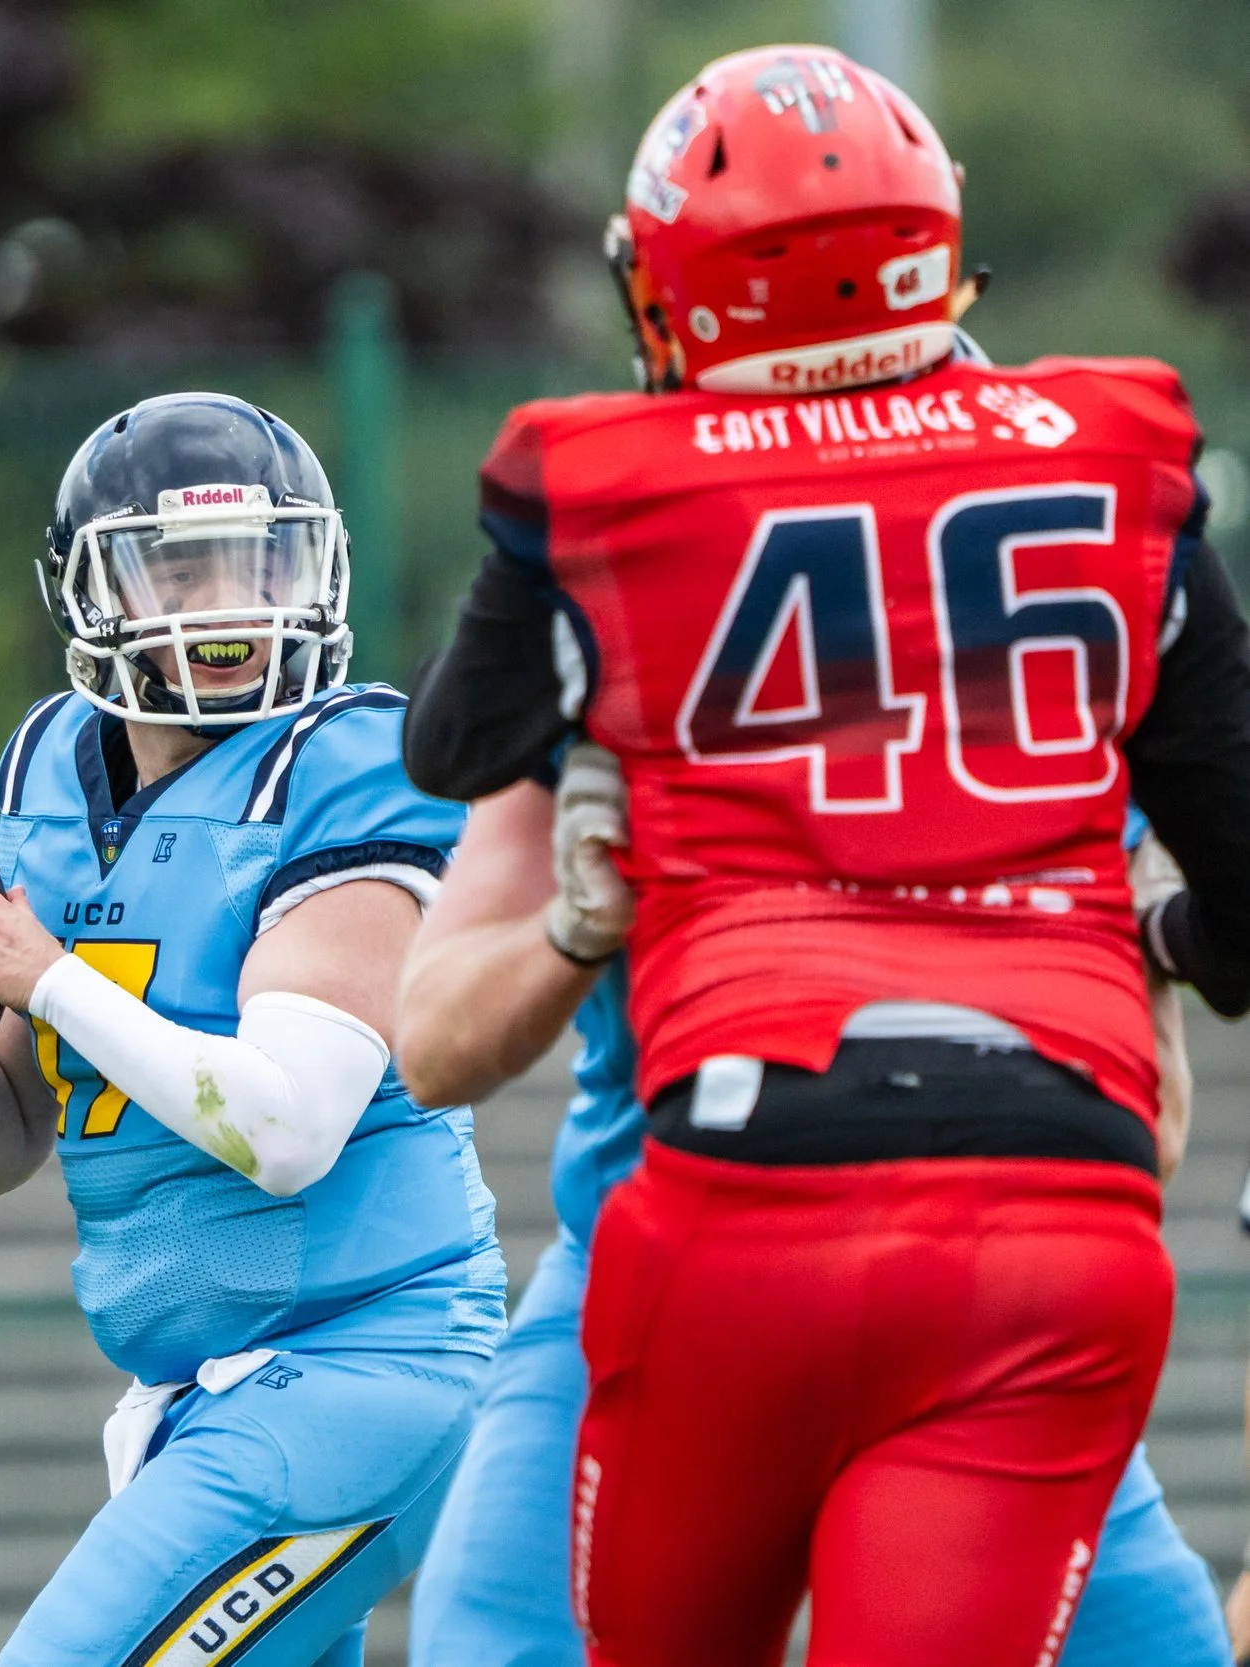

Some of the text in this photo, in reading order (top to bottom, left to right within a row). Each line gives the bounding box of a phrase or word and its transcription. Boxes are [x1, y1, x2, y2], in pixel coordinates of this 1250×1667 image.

[771, 339, 922, 389] Riddell
[693, 407, 790, 454] EAST
[795, 389, 976, 445] VILLAGE
[183, 487, 244, 506] Riddell
[675, 481, 1130, 815] 46
[63, 901, 125, 926] UCD
[188, 1562, 295, 1654] UCD
